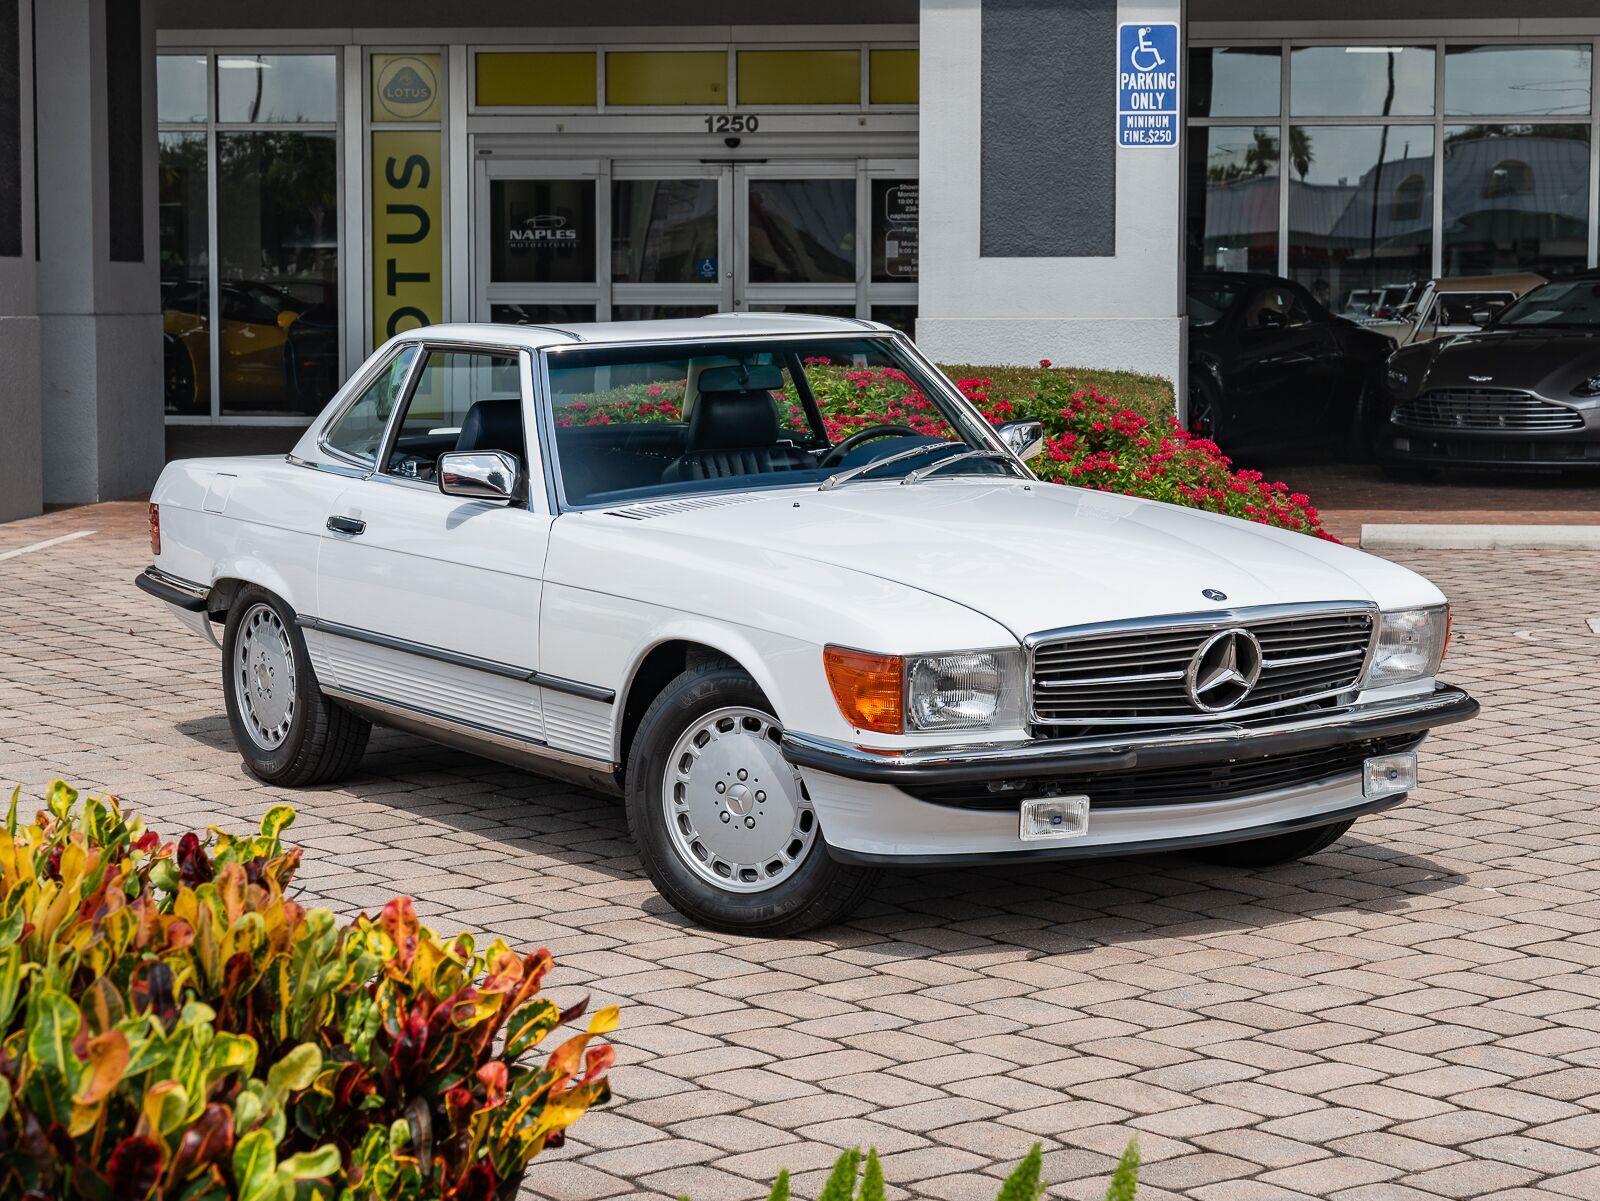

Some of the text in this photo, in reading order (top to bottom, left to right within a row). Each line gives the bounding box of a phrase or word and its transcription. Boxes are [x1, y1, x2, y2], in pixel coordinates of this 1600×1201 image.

[1121, 73, 1176, 90] PARKING
[387, 88, 428, 98] LOTUS
[1131, 92, 1165, 110] ONLY
[705, 116, 759, 133] 1250
[1127, 116, 1169, 128] MINIMUM
[1124, 129, 1172, 143] FINE $250
[510, 229, 577, 240] NAPLES
